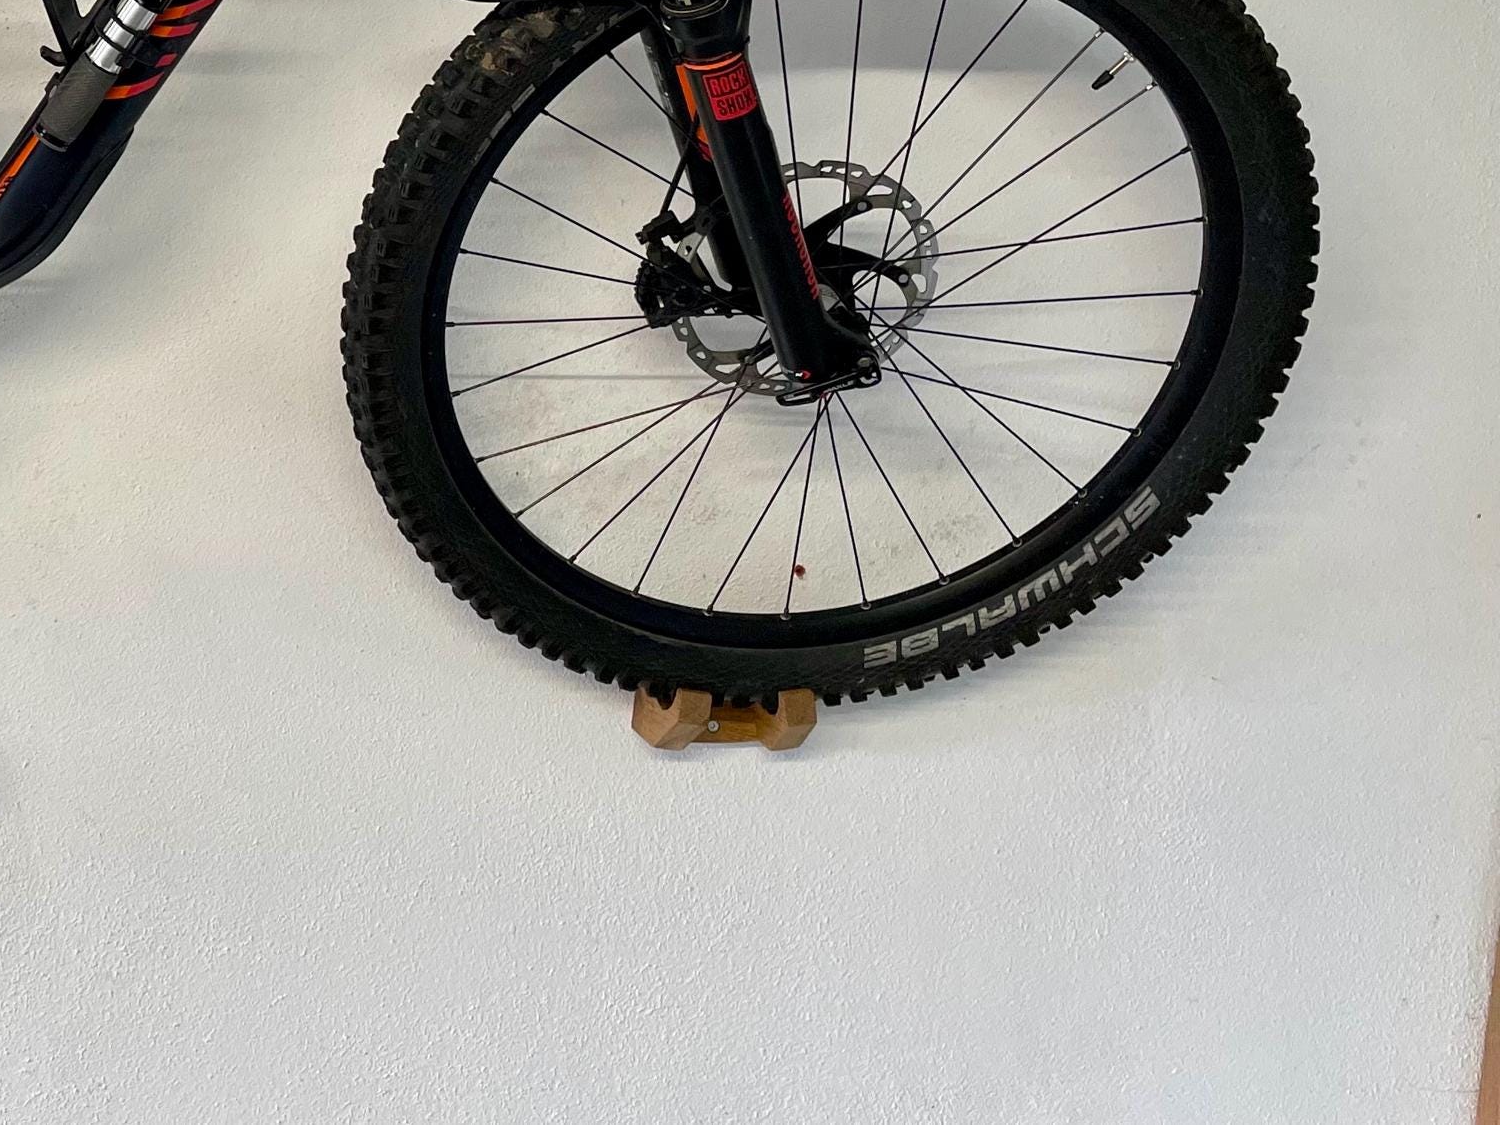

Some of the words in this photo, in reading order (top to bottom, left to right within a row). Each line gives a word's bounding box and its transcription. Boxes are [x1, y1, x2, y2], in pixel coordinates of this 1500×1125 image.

[709, 67, 747, 95] ROCK
[716, 87, 754, 116] SHOX
[863, 486, 1161, 669] SCHWALBE
